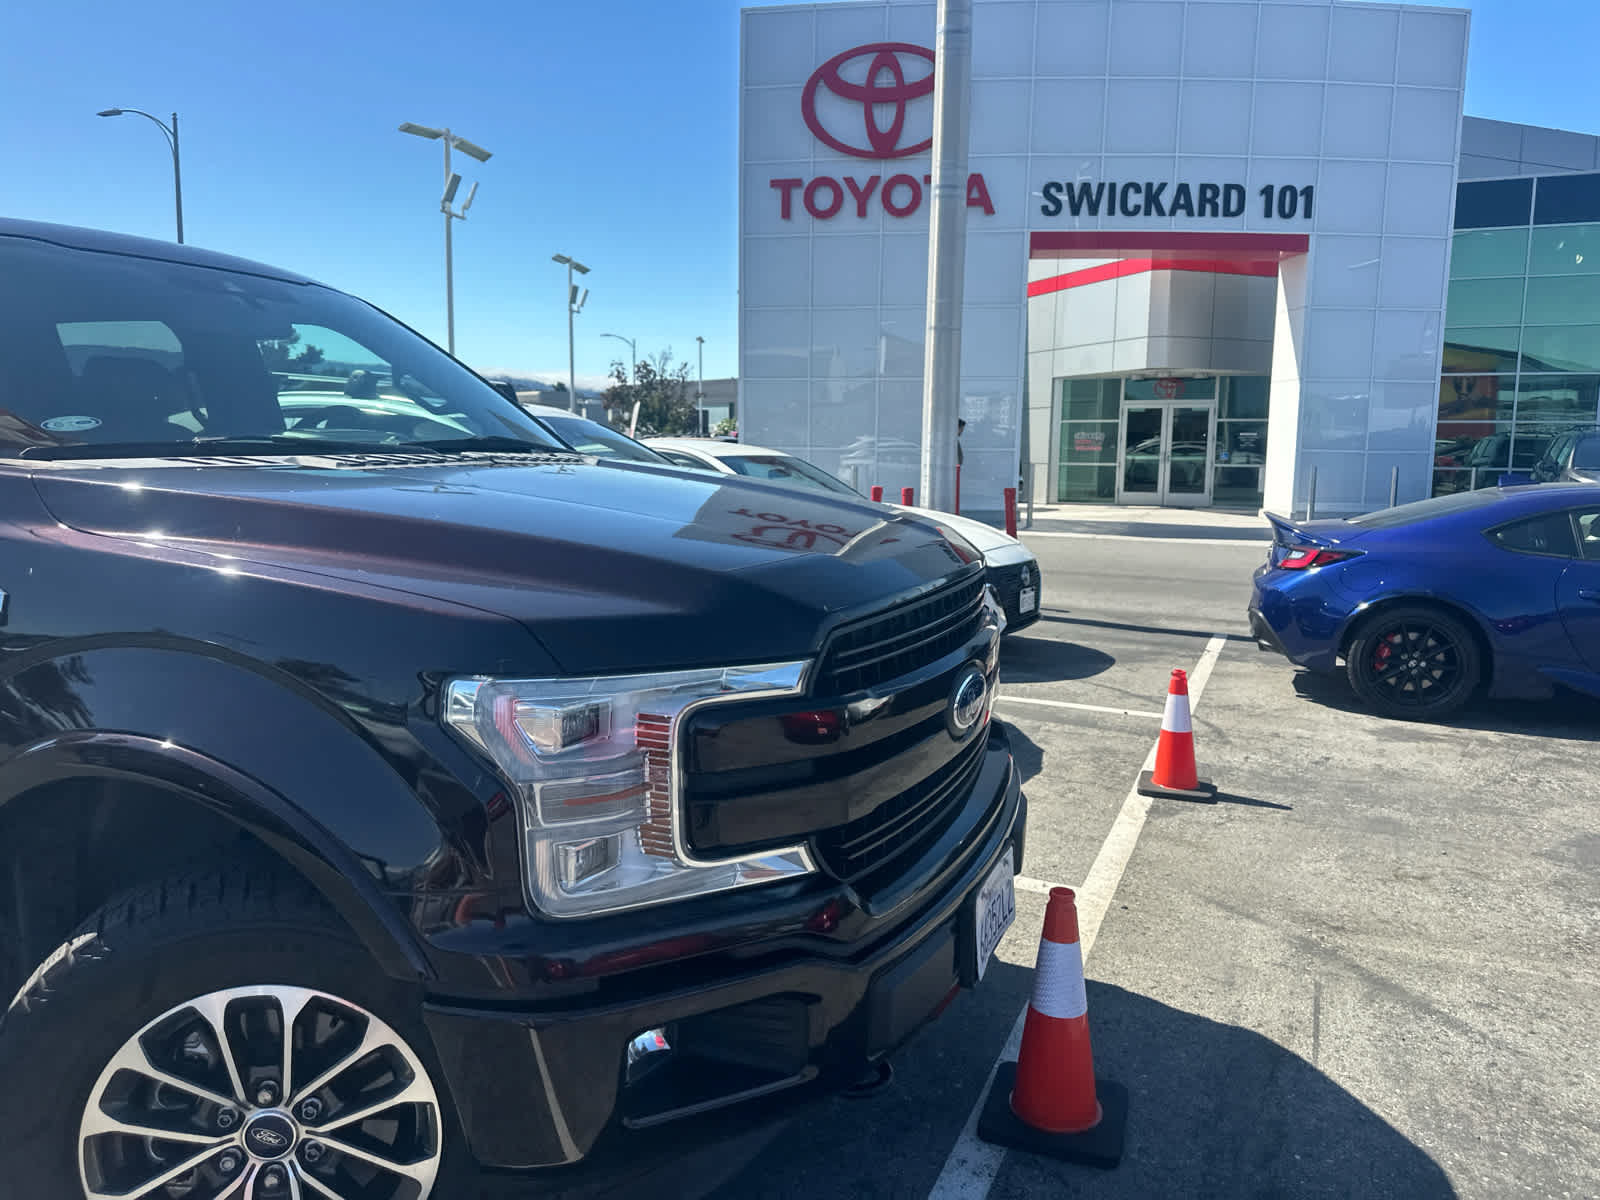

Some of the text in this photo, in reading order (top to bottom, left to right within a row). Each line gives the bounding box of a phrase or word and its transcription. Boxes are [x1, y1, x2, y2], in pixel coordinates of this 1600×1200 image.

[769, 173, 996, 220] TOYOA
[1040, 182, 1315, 219] SWICKARD 101
